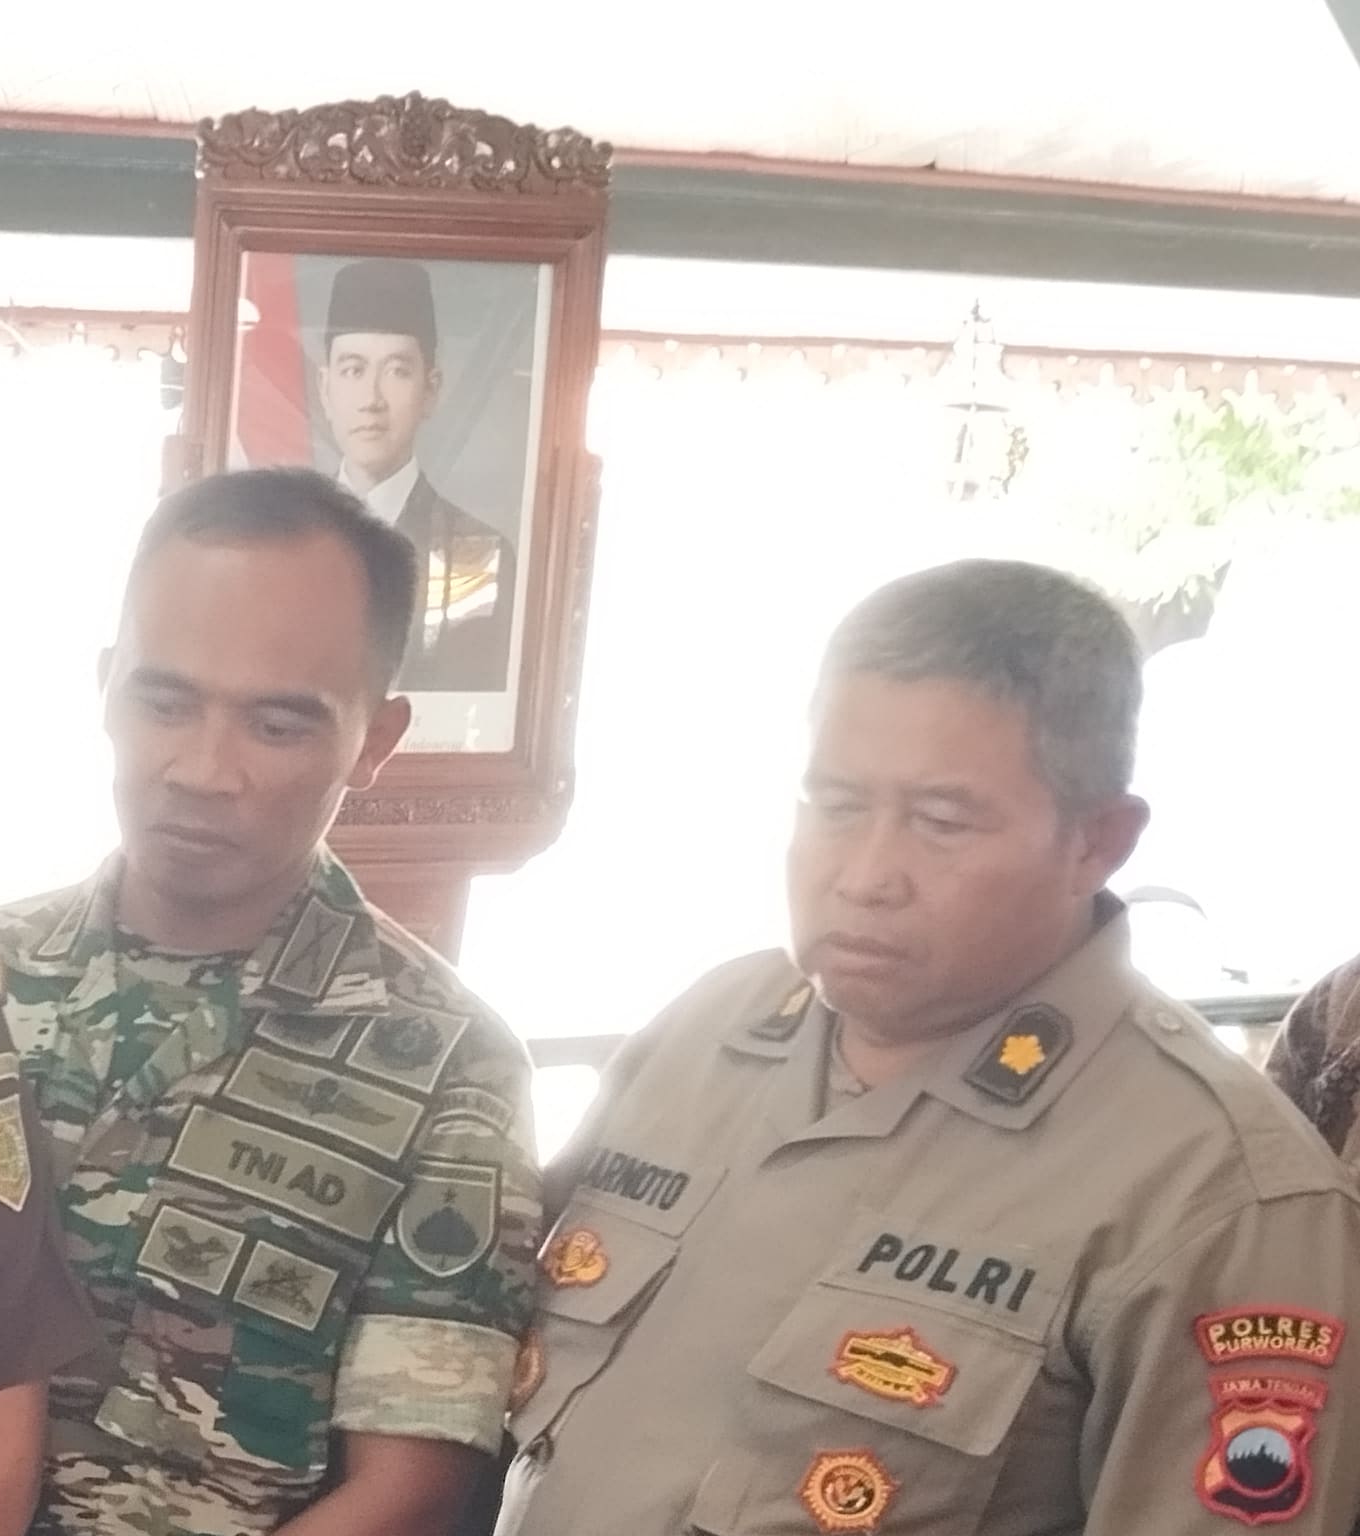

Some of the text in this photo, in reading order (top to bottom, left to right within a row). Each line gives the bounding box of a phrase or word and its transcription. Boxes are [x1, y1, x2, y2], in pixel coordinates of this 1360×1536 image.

[228, 1138, 347, 1208] TNI AD
[856, 1232, 1037, 1314] POLRI
[1208, 1315, 1334, 1344] POLRES
[1212, 1335, 1329, 1358] PURWOREJO
